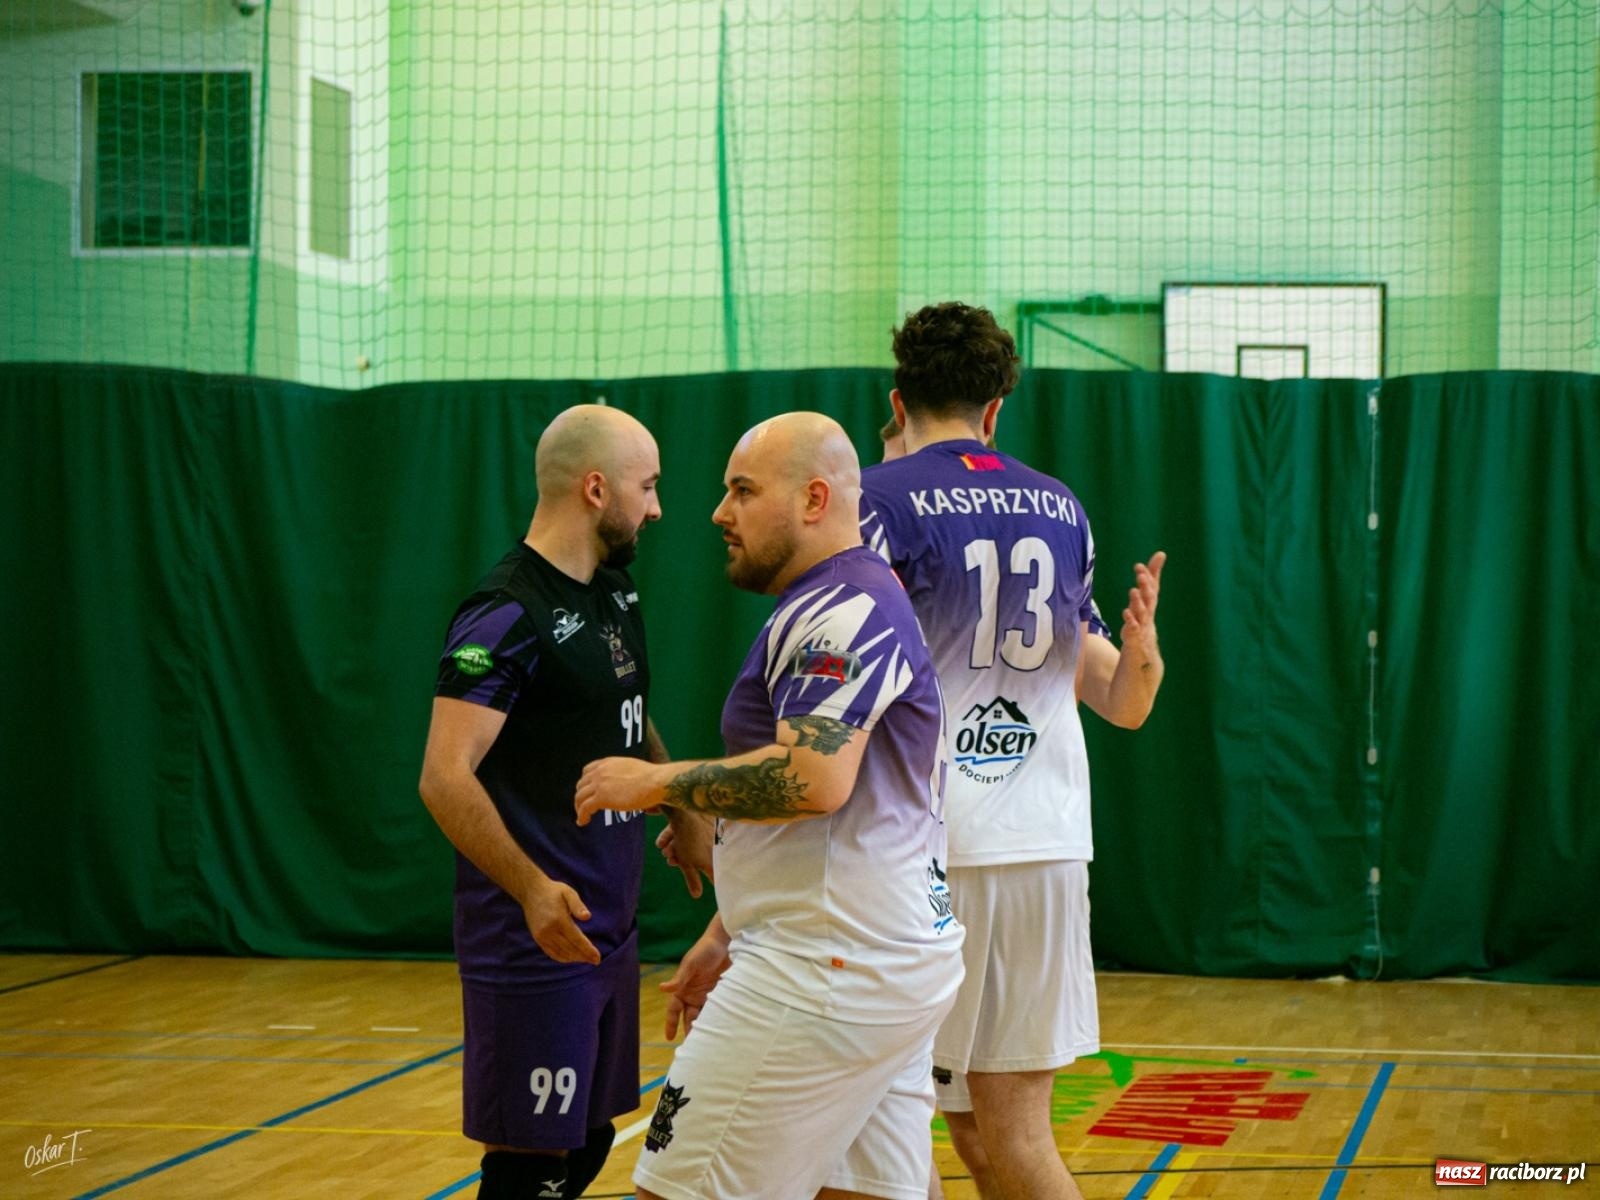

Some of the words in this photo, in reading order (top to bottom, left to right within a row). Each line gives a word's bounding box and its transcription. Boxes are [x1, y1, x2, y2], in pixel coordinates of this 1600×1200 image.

[909, 487, 1077, 527] KASPRZYCKI
[964, 536, 1055, 671] 13
[620, 695, 643, 748] 99
[956, 721, 1037, 755] olsen
[530, 1067, 577, 1115] 99
